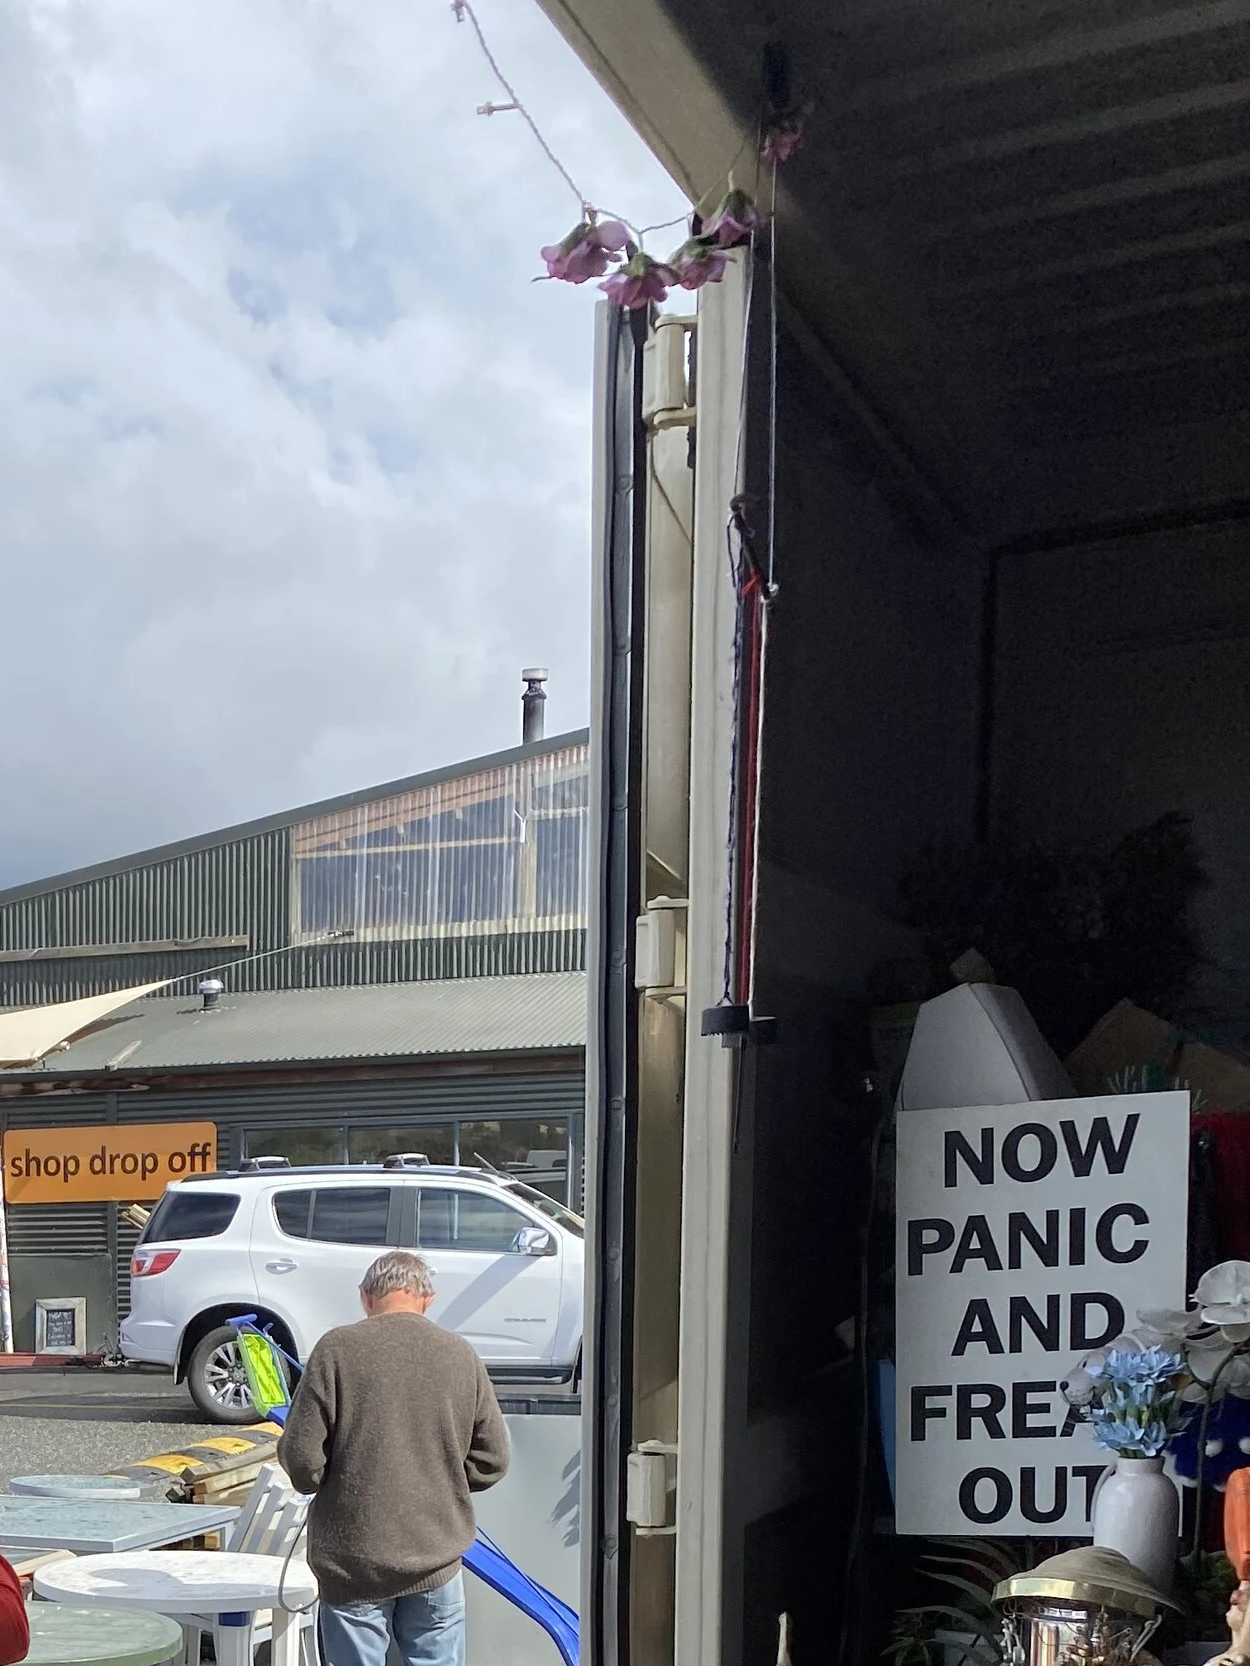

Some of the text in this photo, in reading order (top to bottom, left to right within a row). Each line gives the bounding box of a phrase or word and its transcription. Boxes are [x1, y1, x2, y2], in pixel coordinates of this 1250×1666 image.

[10, 1142, 212, 1183] shop drop off
[944, 1113, 1141, 1188] NOW
[907, 1202, 1150, 1277] PANIC
[951, 1291, 1125, 1357] AND
[910, 1380, 1106, 1442] FRE
[958, 1464, 1117, 1525] OUT
